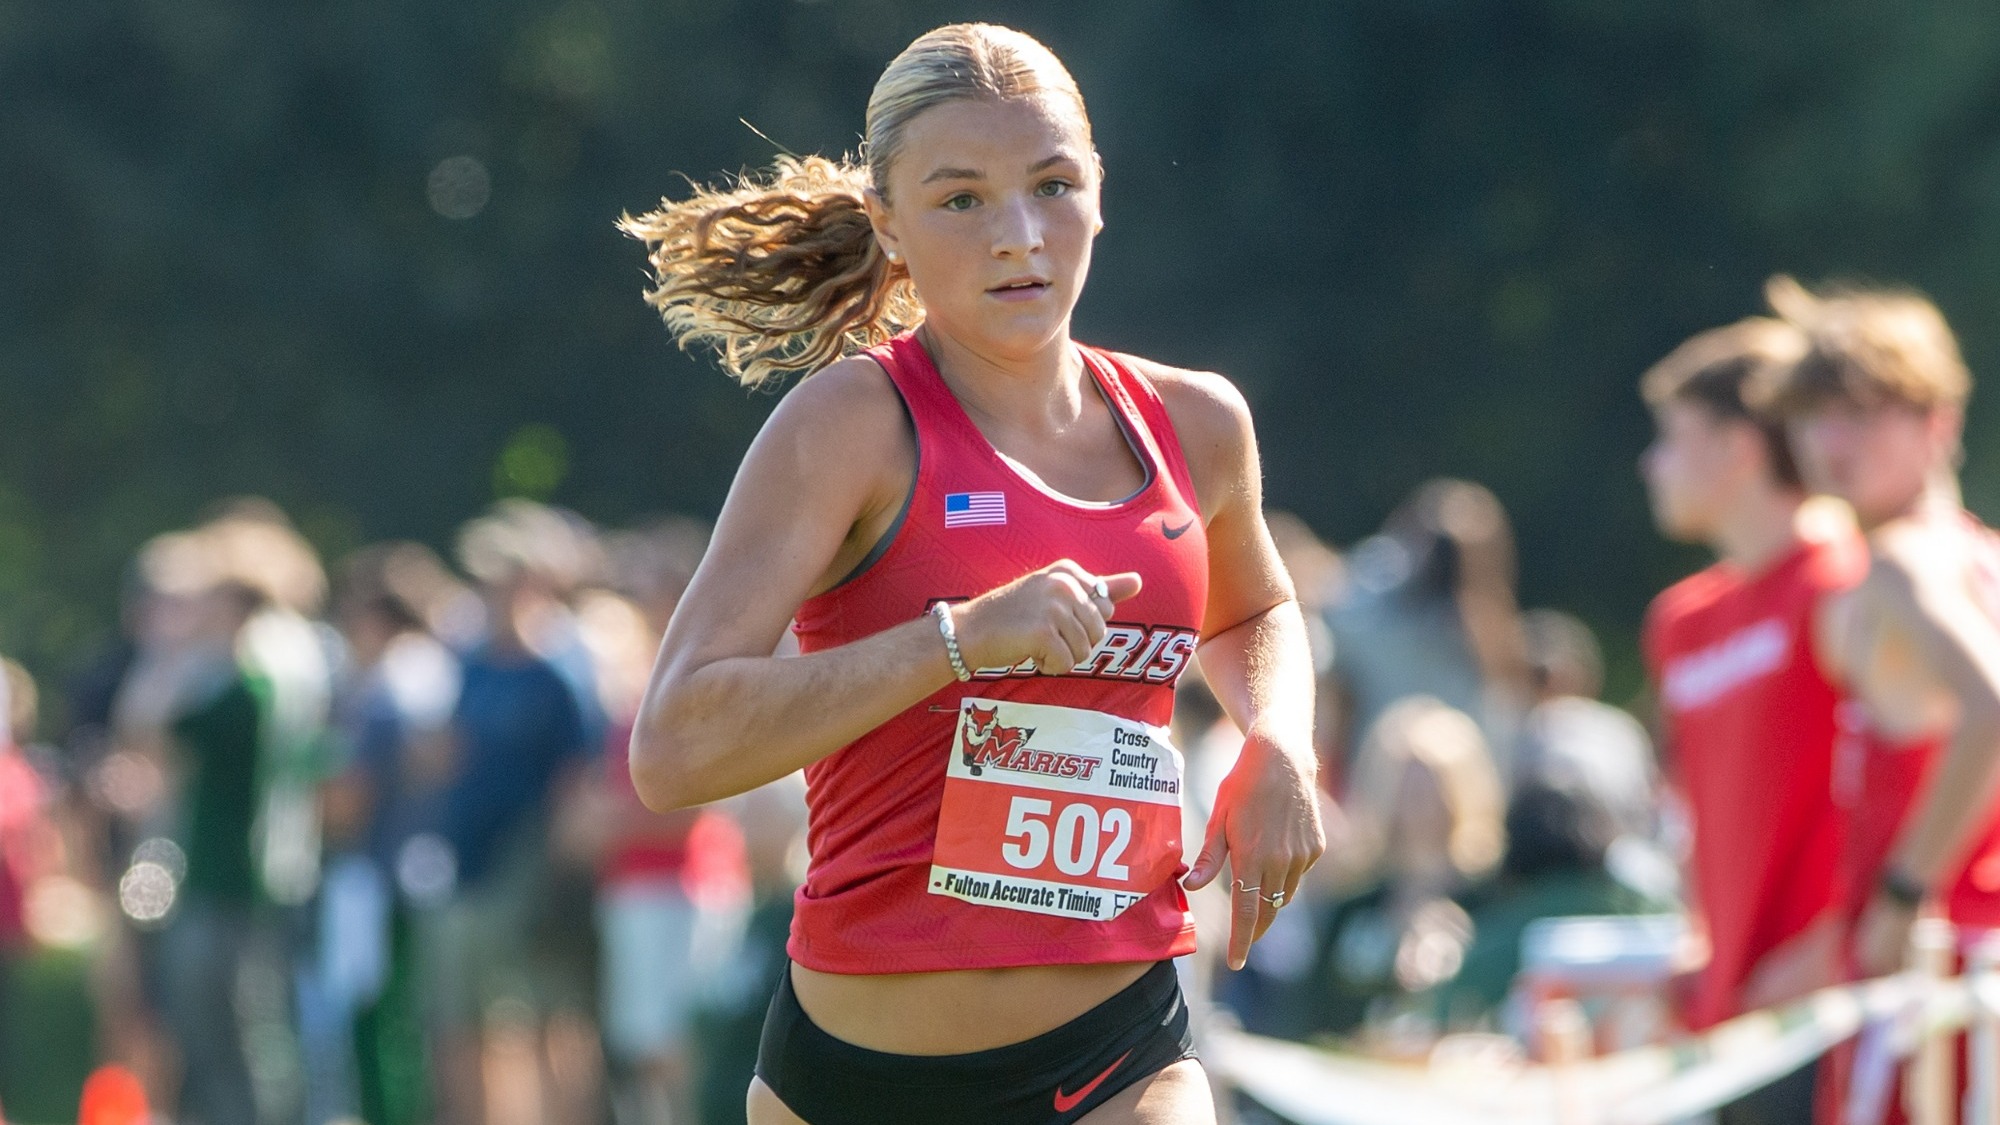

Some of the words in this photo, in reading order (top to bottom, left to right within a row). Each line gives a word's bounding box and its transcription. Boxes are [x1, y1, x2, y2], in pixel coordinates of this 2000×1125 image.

[1114, 727, 1150, 747] Cross
[974, 736, 1102, 780] MARIST
[1112, 748, 1158, 773] Country
[1109, 769, 1180, 795] Invitational
[1002, 795, 1132, 881] 502
[944, 873, 990, 898] Fulton
[990, 880, 1054, 907] Accurate
[1057, 888, 1102, 918] Timing
